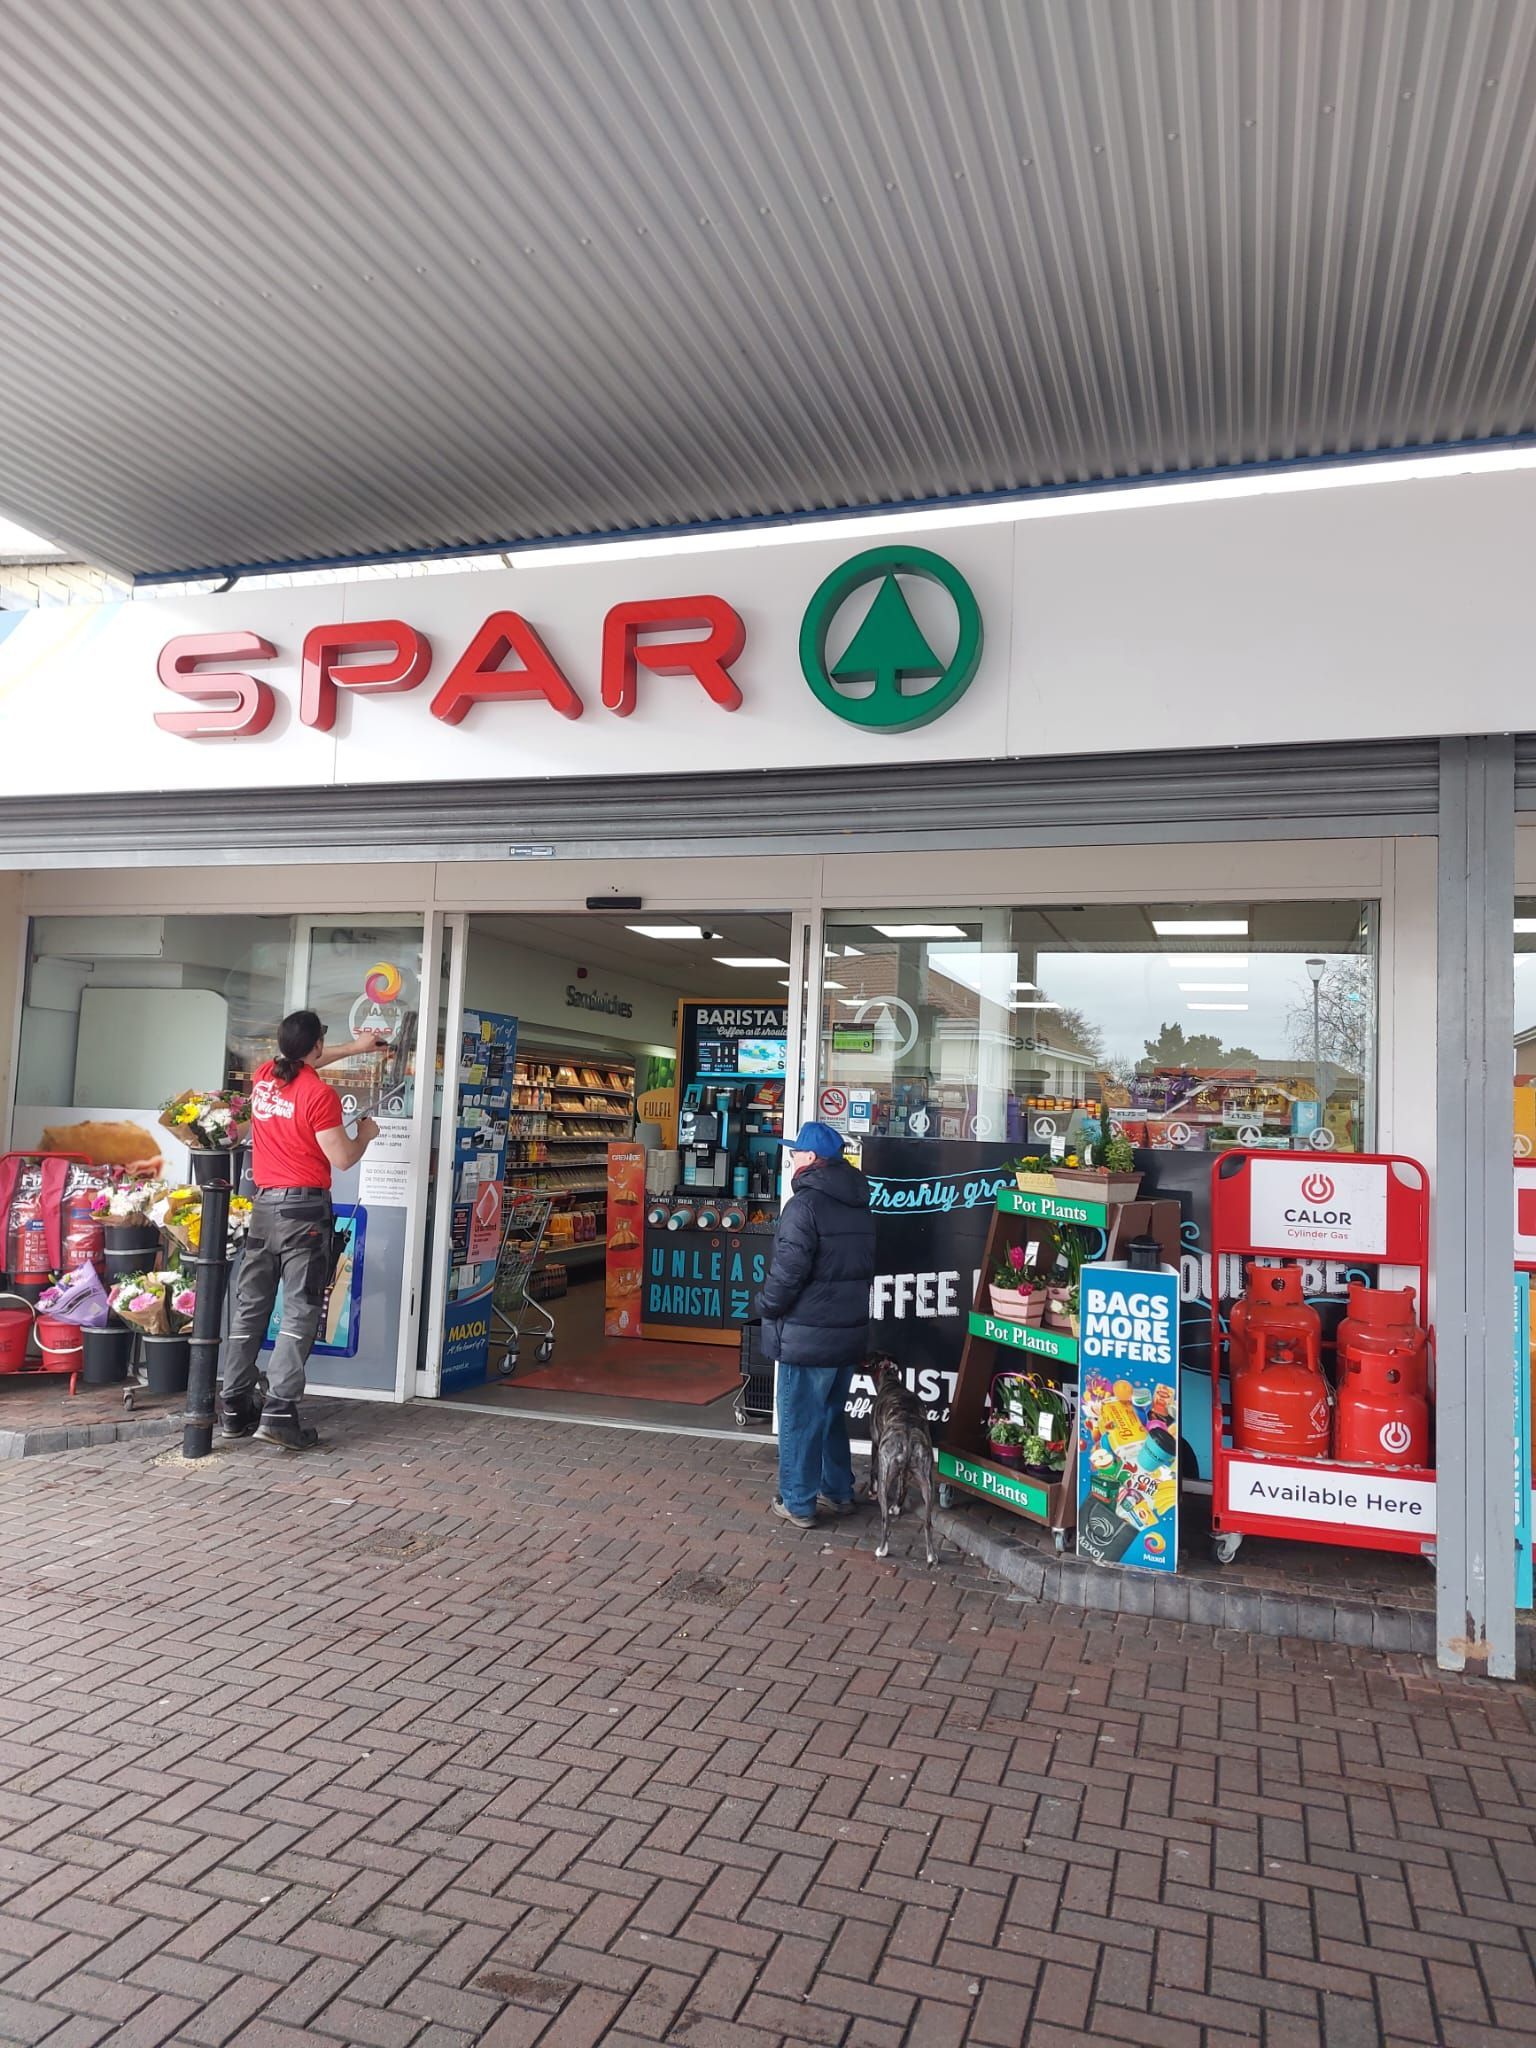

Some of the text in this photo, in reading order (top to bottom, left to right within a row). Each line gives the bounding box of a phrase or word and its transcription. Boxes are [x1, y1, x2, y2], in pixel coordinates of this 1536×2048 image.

[154, 594, 747, 739] SPAR
[566, 984, 633, 1019] Sandwiches
[697, 1009, 779, 1026] BARISTA
[717, 1026, 745, 1038] Coffee
[643, 1101, 672, 1118] FULFIL
[868, 1178, 960, 1212] Freshly
[1013, 1194, 1087, 1221] Pot Plants
[1284, 1208, 1352, 1225] CALOR
[1287, 1229, 1349, 1240] Cylinder Gas
[651, 1248, 765, 1283] UNLEAS
[650, 1284, 721, 1318] BARISTA
[868, 1271, 960, 1320] FFEE
[1087, 1289, 1169, 1320] BAGS
[448, 1320, 487, 1343] MAXOL
[984, 1318, 1059, 1355] Pot Plants
[1086, 1314, 1170, 1344] MORE
[1084, 1337, 1171, 1364] OFFERS
[954, 1460, 1028, 1506] Pot Plants
[1250, 1480, 1423, 1515] Available Here
[1143, 1553, 1166, 1564] Maxol
